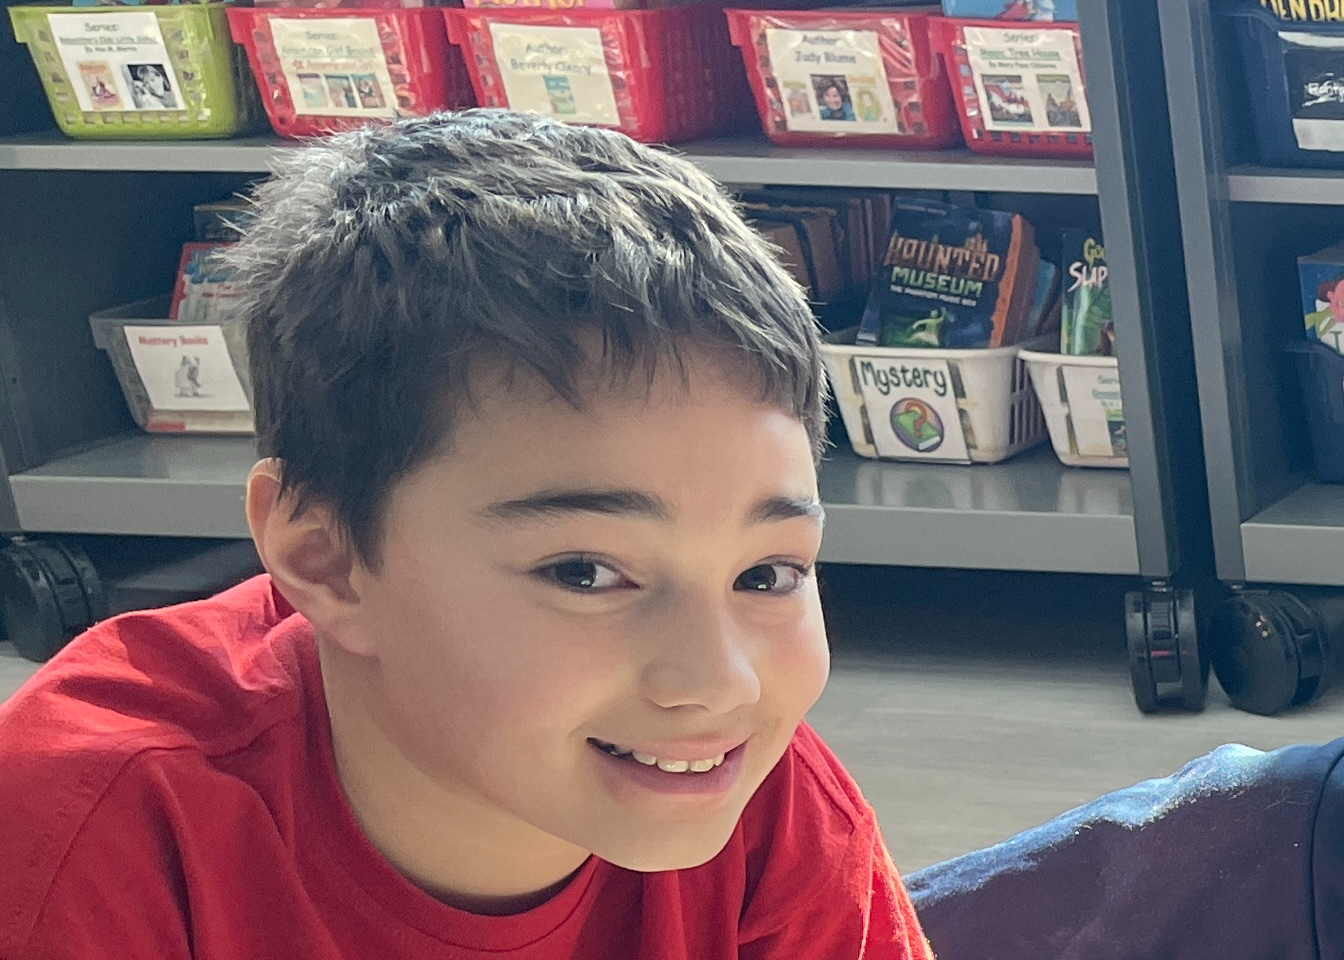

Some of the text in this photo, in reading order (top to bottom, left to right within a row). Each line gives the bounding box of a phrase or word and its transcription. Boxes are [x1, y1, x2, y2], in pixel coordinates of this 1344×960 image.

[884, 232, 1000, 281] HAUNTED
[890, 266, 984, 298] MUSEUM
[859, 360, 948, 397] Mystery
